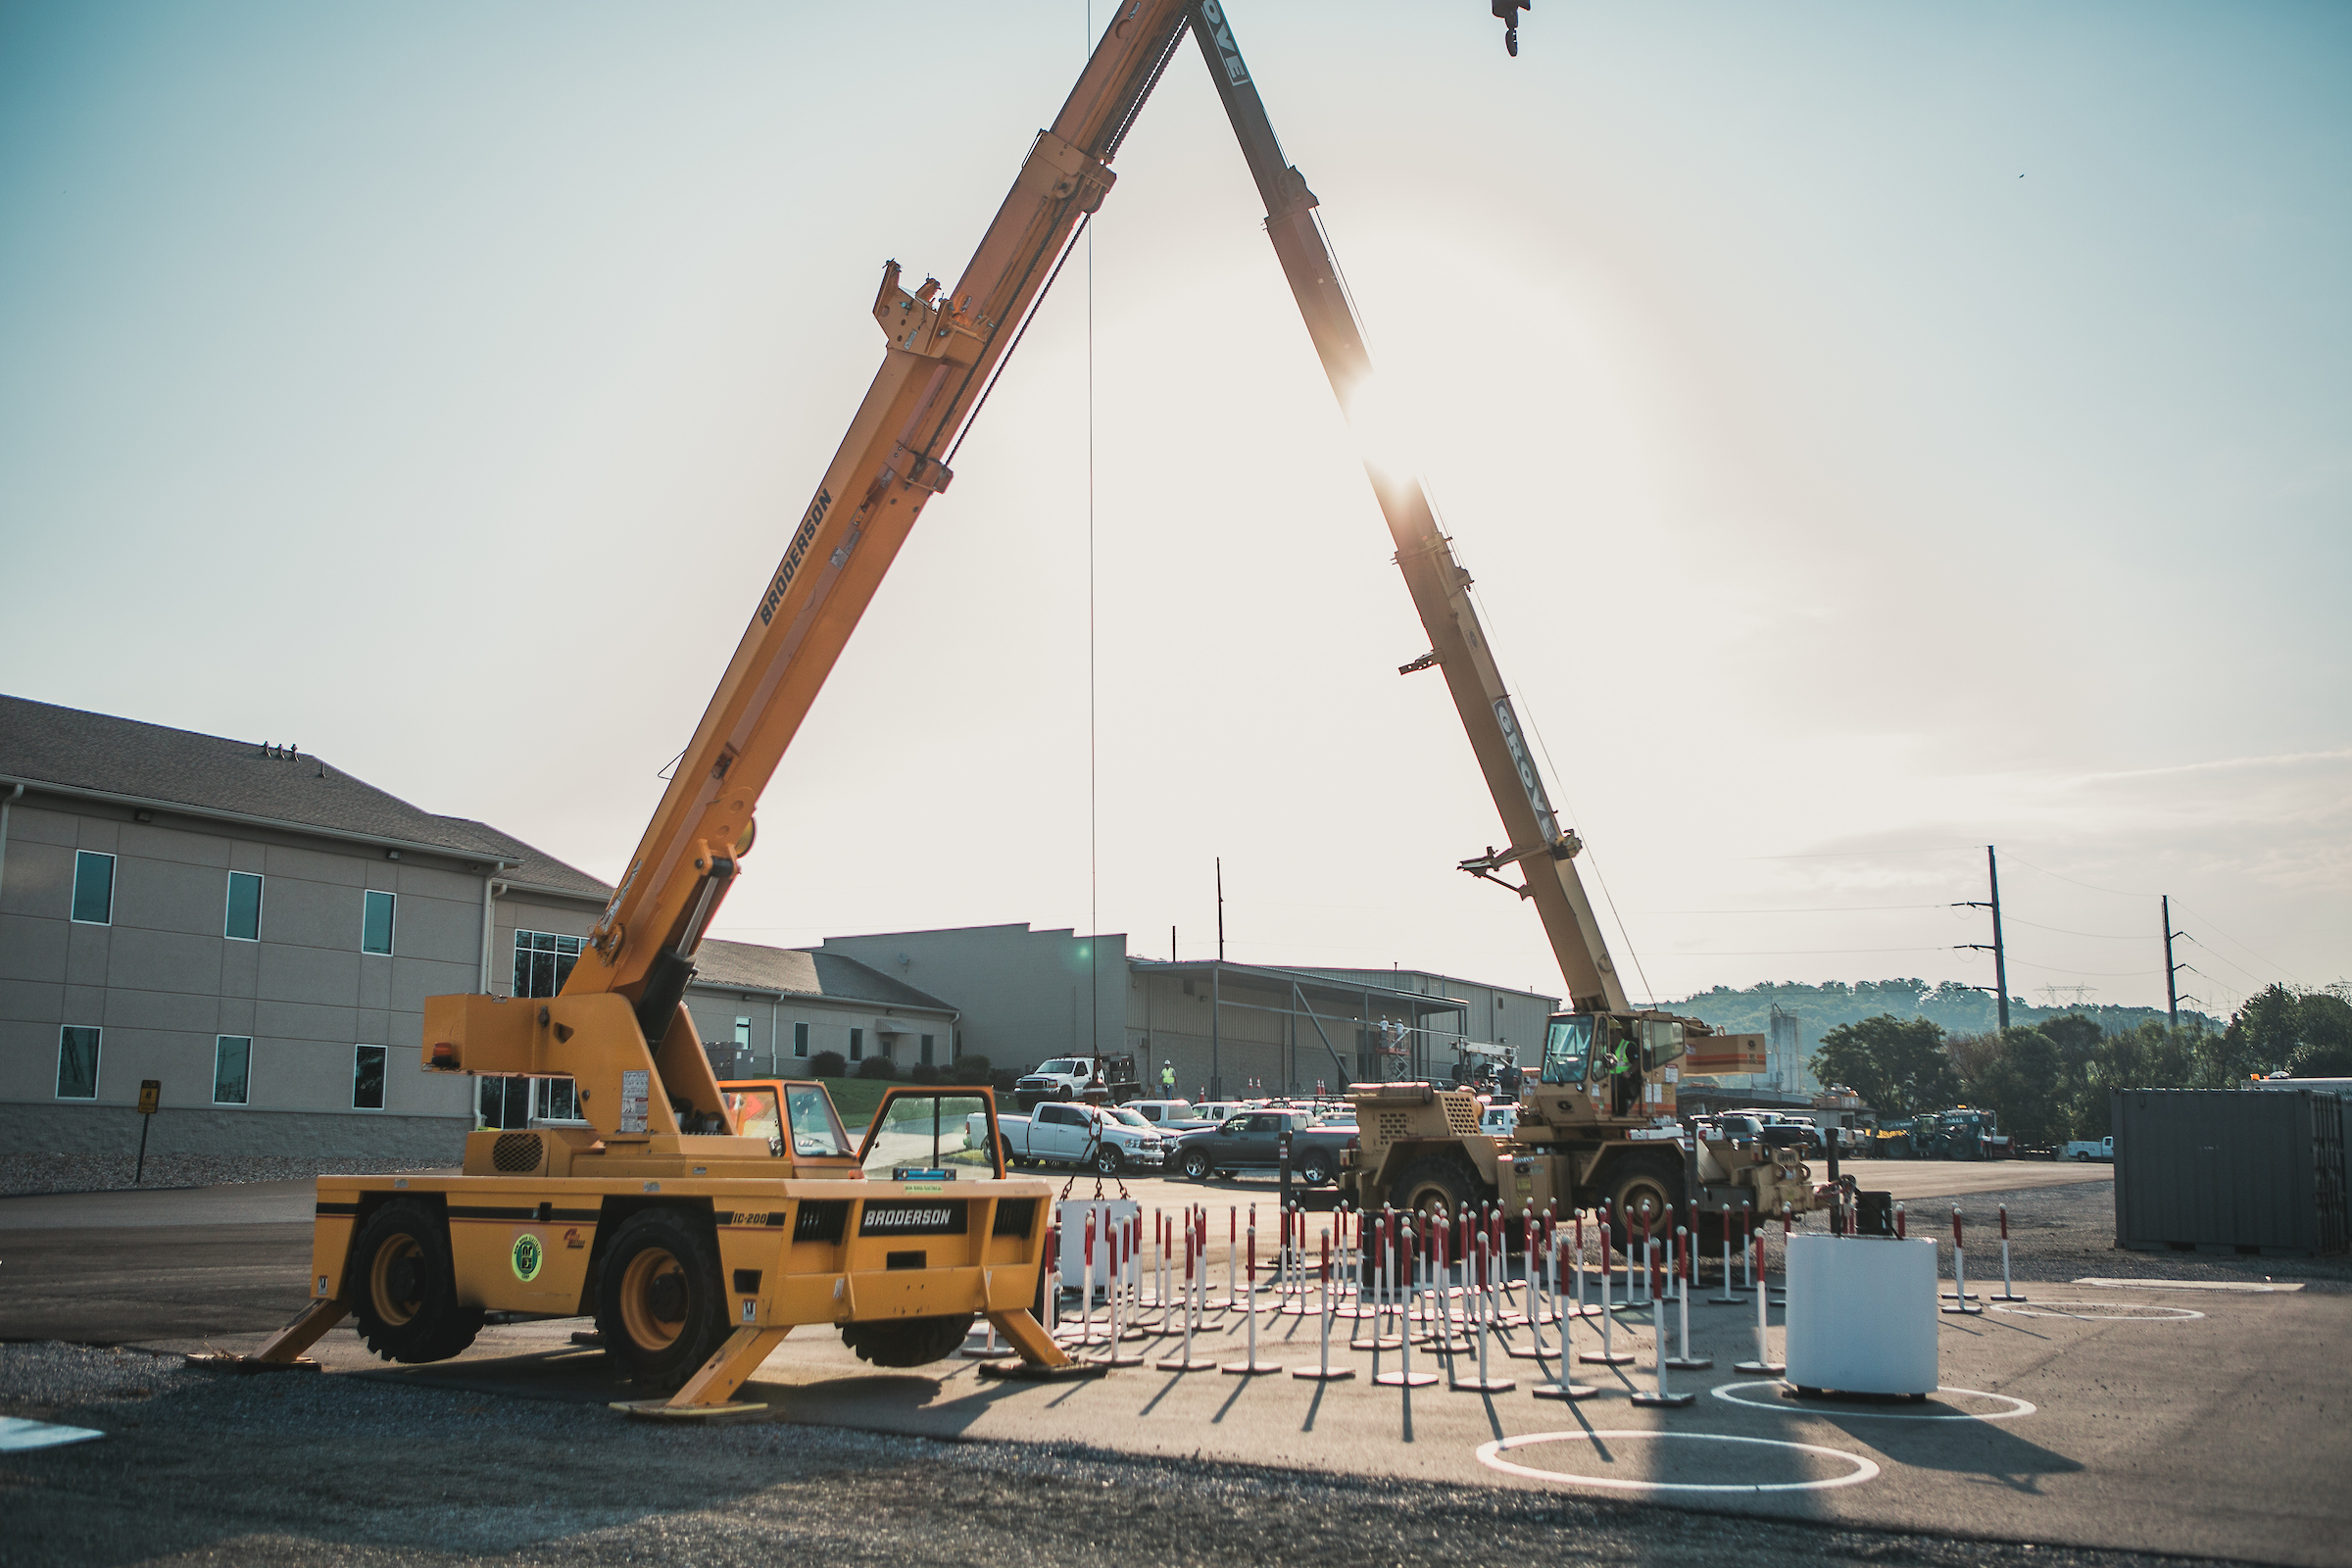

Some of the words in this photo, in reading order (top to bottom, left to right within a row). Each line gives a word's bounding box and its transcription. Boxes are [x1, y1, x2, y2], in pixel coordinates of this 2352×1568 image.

[760, 488, 832, 627] BRODERSON
[1497, 705, 1554, 839] GROVE
[733, 1212, 767, 1224] IC-200
[864, 1208, 952, 1226] BRODERSON
